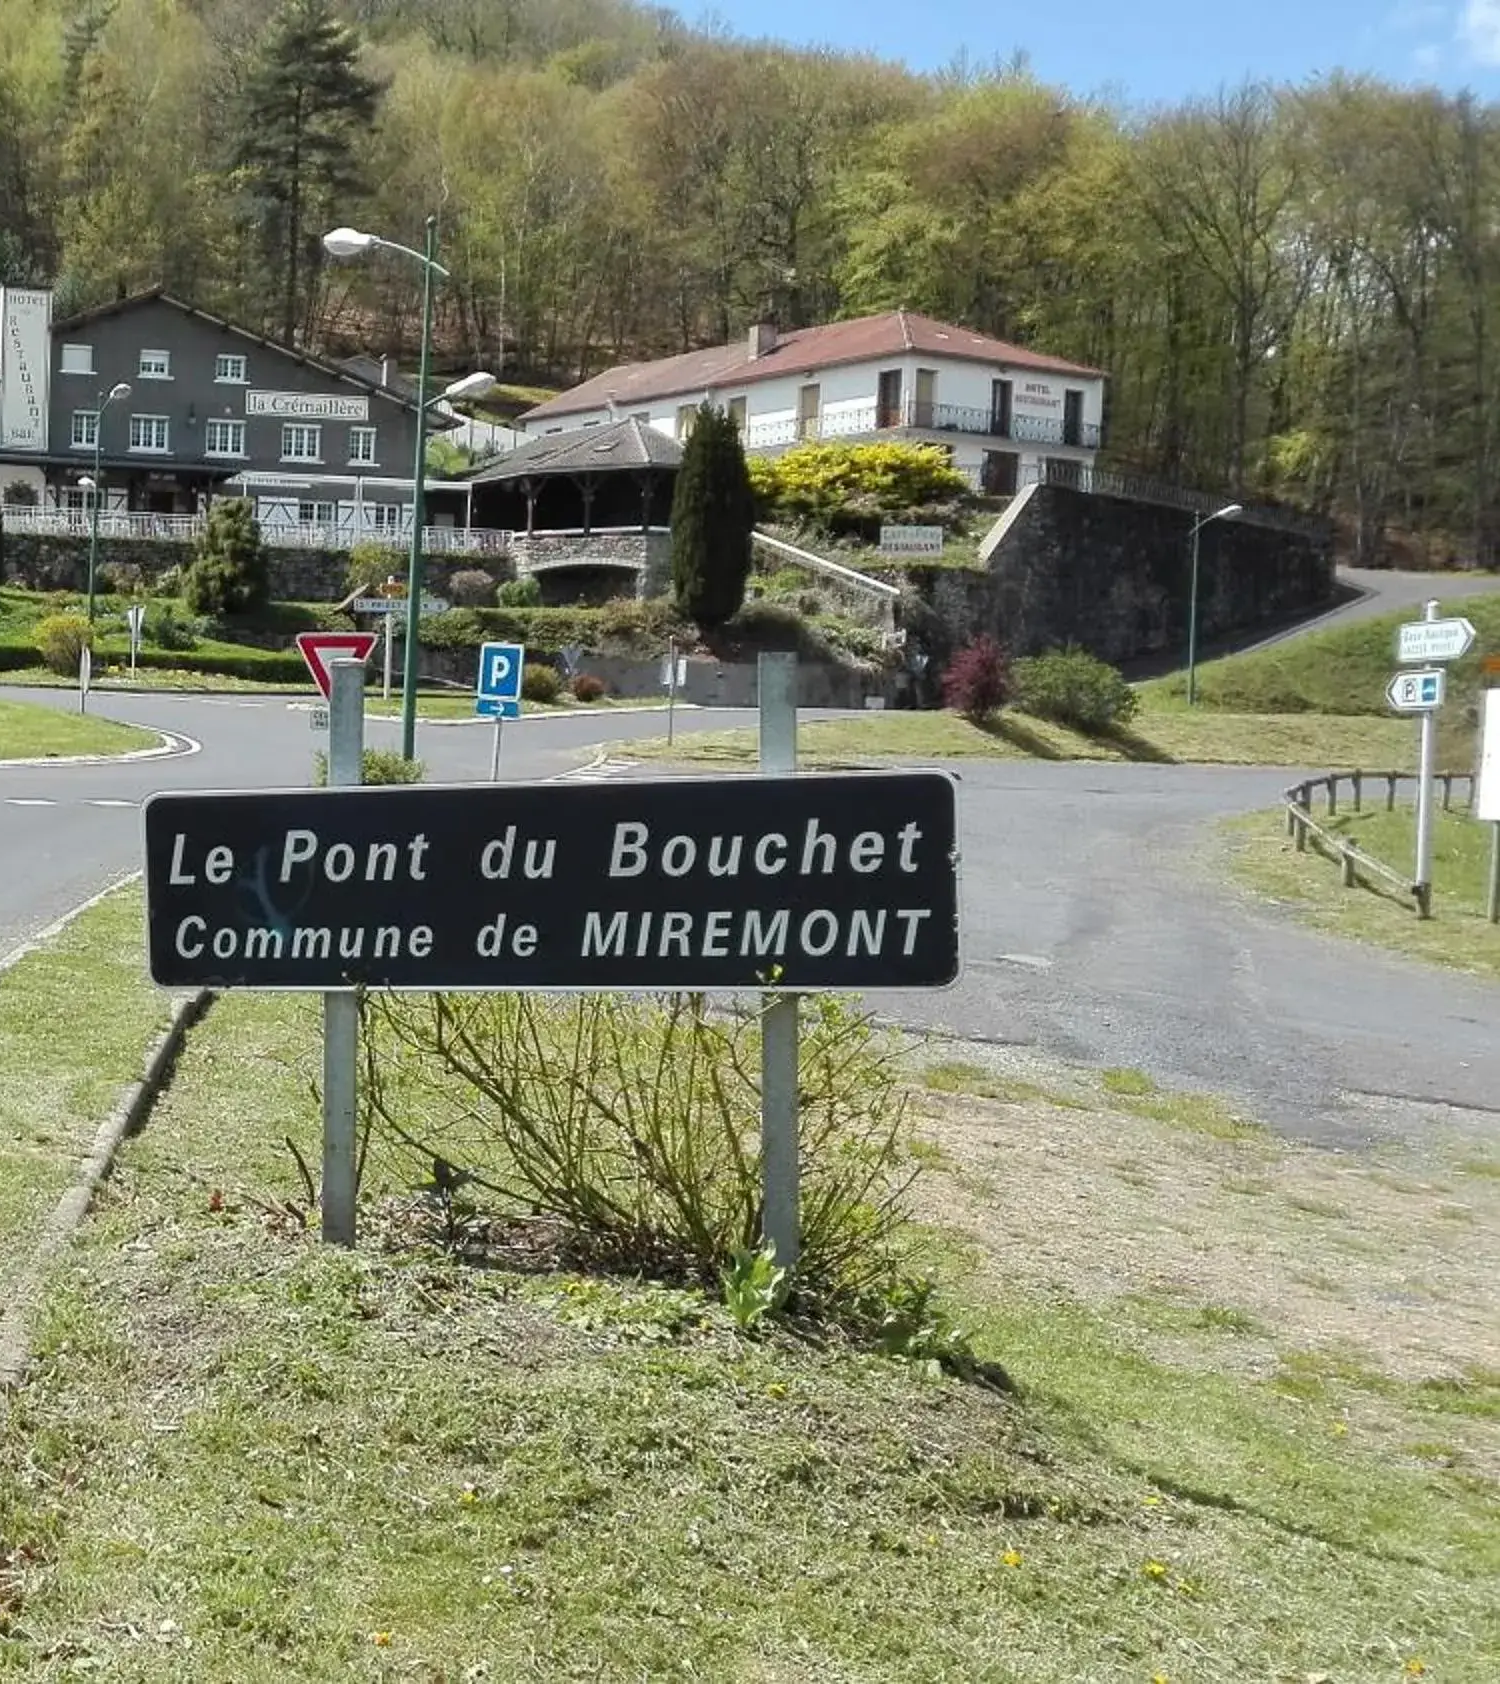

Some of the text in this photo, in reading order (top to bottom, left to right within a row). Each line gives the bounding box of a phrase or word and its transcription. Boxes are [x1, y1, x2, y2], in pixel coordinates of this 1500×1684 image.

[490, 655, 510, 687] P
[169, 817, 923, 885] Le Pont du Bouchet
[175, 909, 932, 959] Commune de MIREMONT
